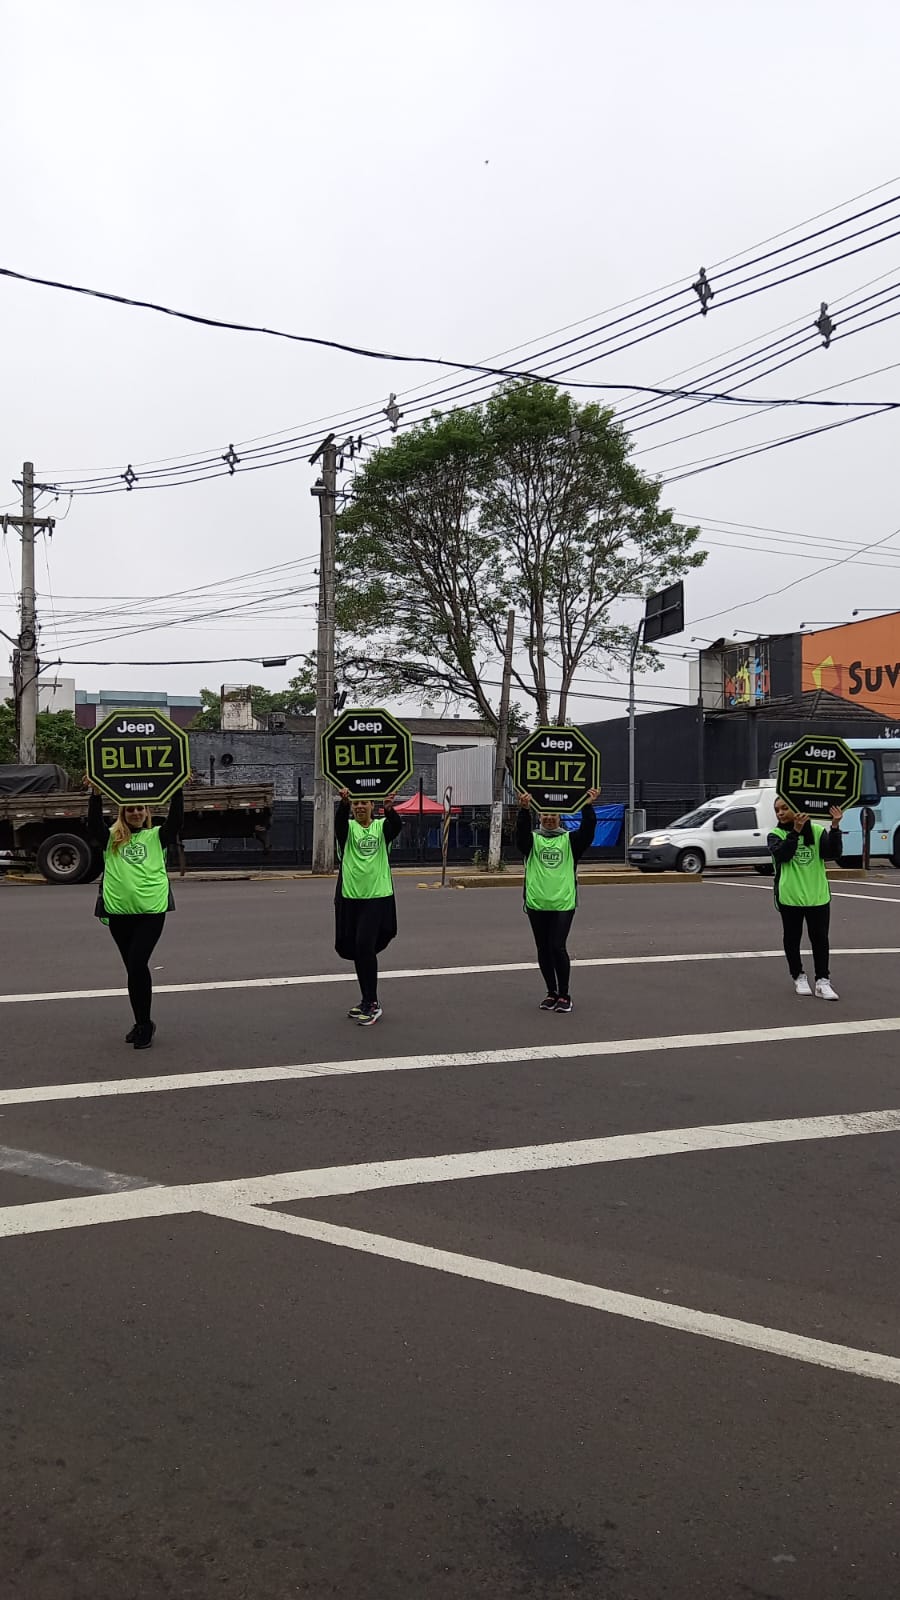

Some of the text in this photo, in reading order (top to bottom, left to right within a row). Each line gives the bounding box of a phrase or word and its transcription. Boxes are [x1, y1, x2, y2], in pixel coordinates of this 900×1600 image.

[116, 720, 156, 736] Jeep
[348, 719, 383, 735] Jeep
[540, 736, 574, 752] Jeep
[804, 745, 837, 761] Jeep
[101, 745, 174, 770] BLITZ
[334, 743, 399, 767] BLITZ
[526, 759, 587, 783] BLITZ
[788, 767, 848, 791] BLITZ
